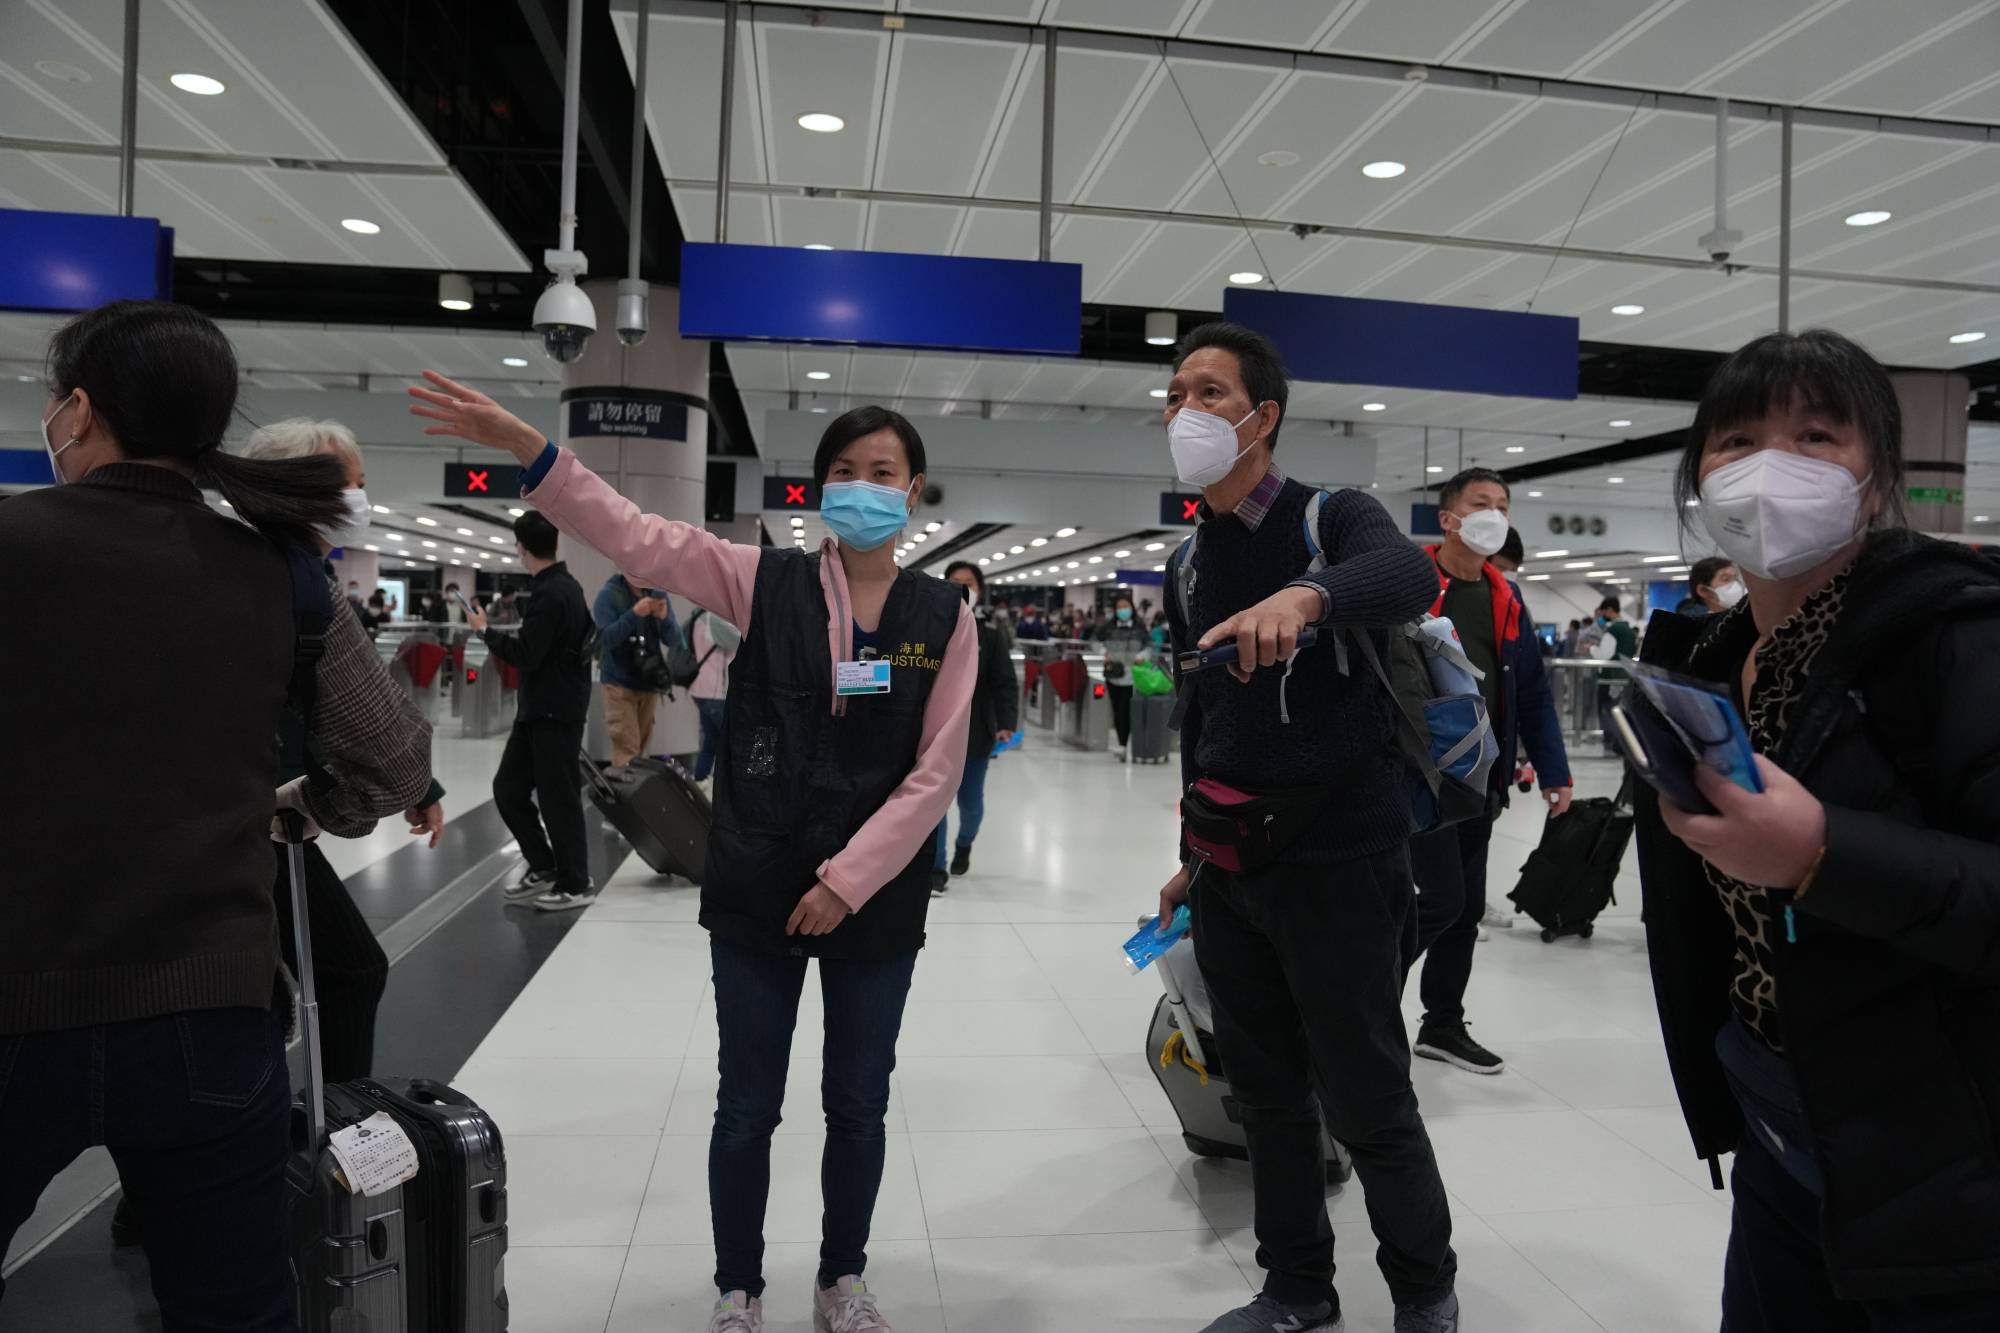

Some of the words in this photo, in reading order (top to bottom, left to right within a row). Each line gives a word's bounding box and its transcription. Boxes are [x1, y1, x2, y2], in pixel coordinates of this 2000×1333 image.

[588, 402, 662, 423] 請勿停留
[600, 423, 613, 432] No
[614, 424, 648, 435] waiting
[880, 654, 941, 671] CUSTOMS
